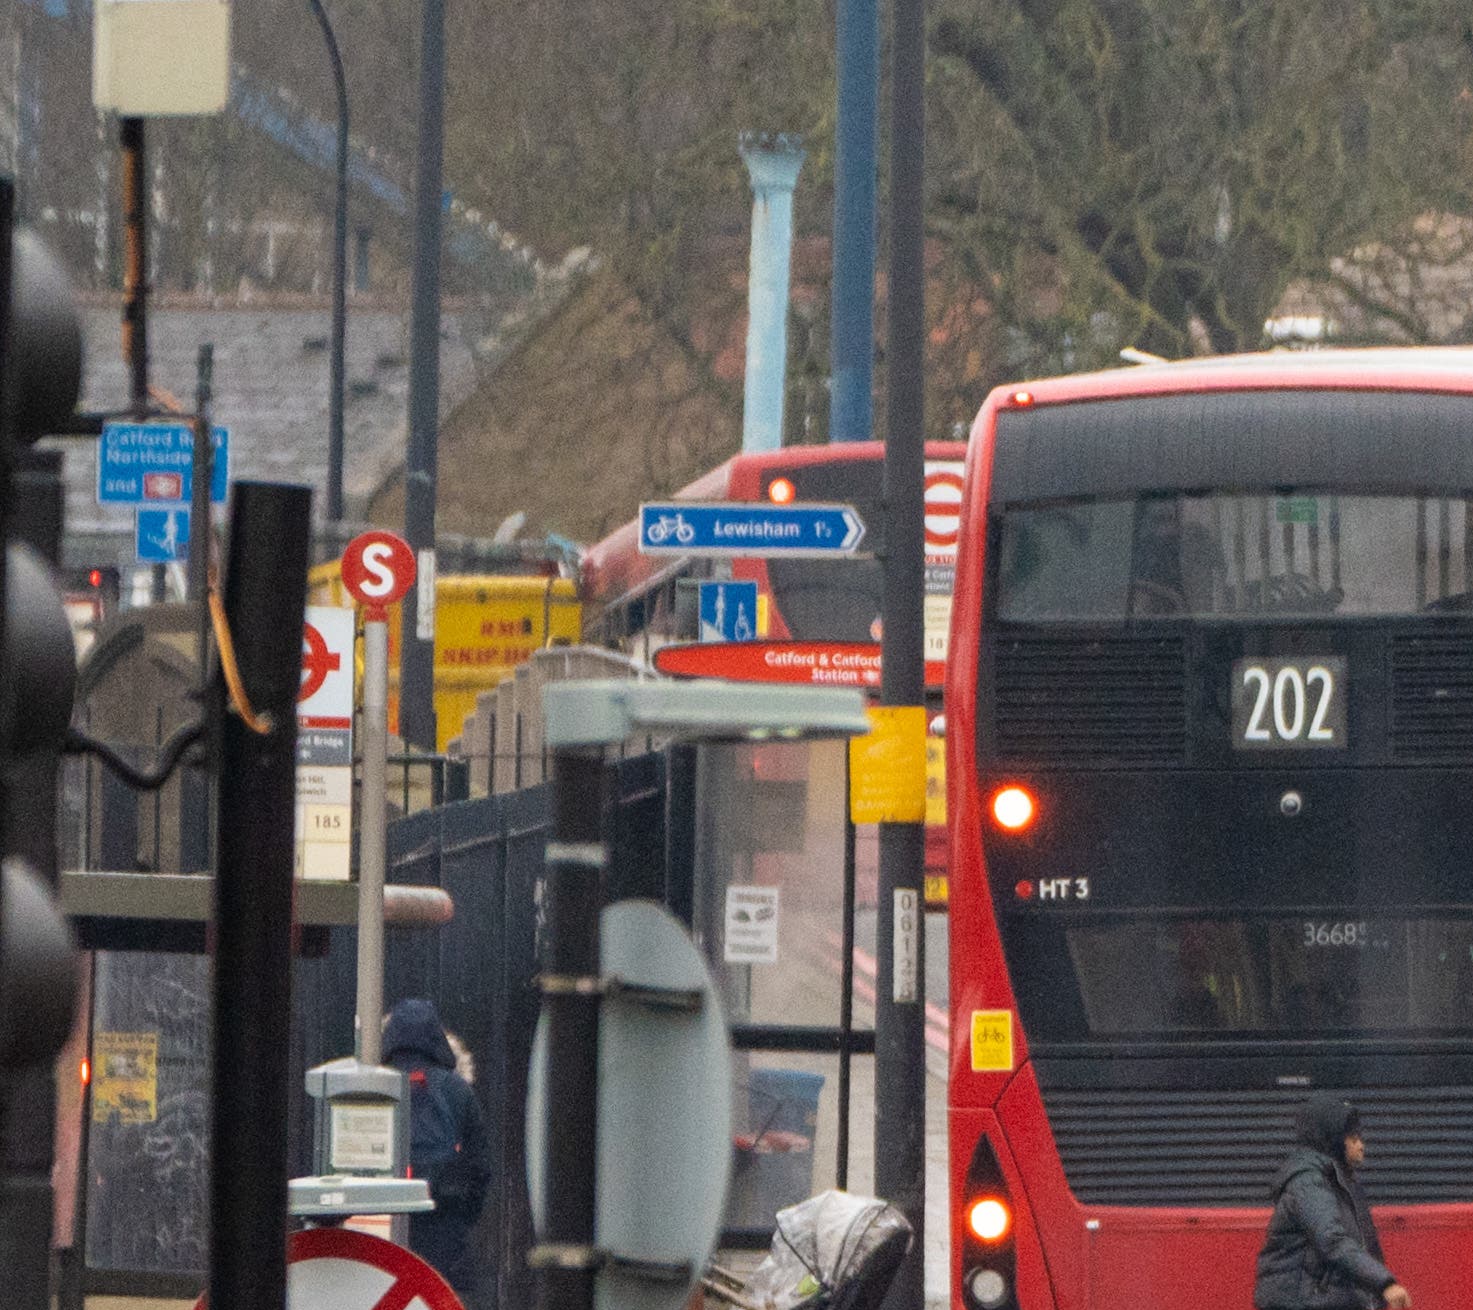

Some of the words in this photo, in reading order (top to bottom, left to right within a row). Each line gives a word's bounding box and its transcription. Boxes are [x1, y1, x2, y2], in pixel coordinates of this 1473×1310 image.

[713, 519, 799, 537] Lewisham
[359, 542, 395, 597] S
[764, 651, 815, 666] Catford
[818, 653, 829, 666] &
[832, 653, 882, 668] Catford
[811, 668, 857, 681] Station
[1242, 667, 1334, 742] 202
[314, 814, 341, 828] 185
[1039, 878, 1070, 900] HT
[1075, 878, 1090, 899] 3
